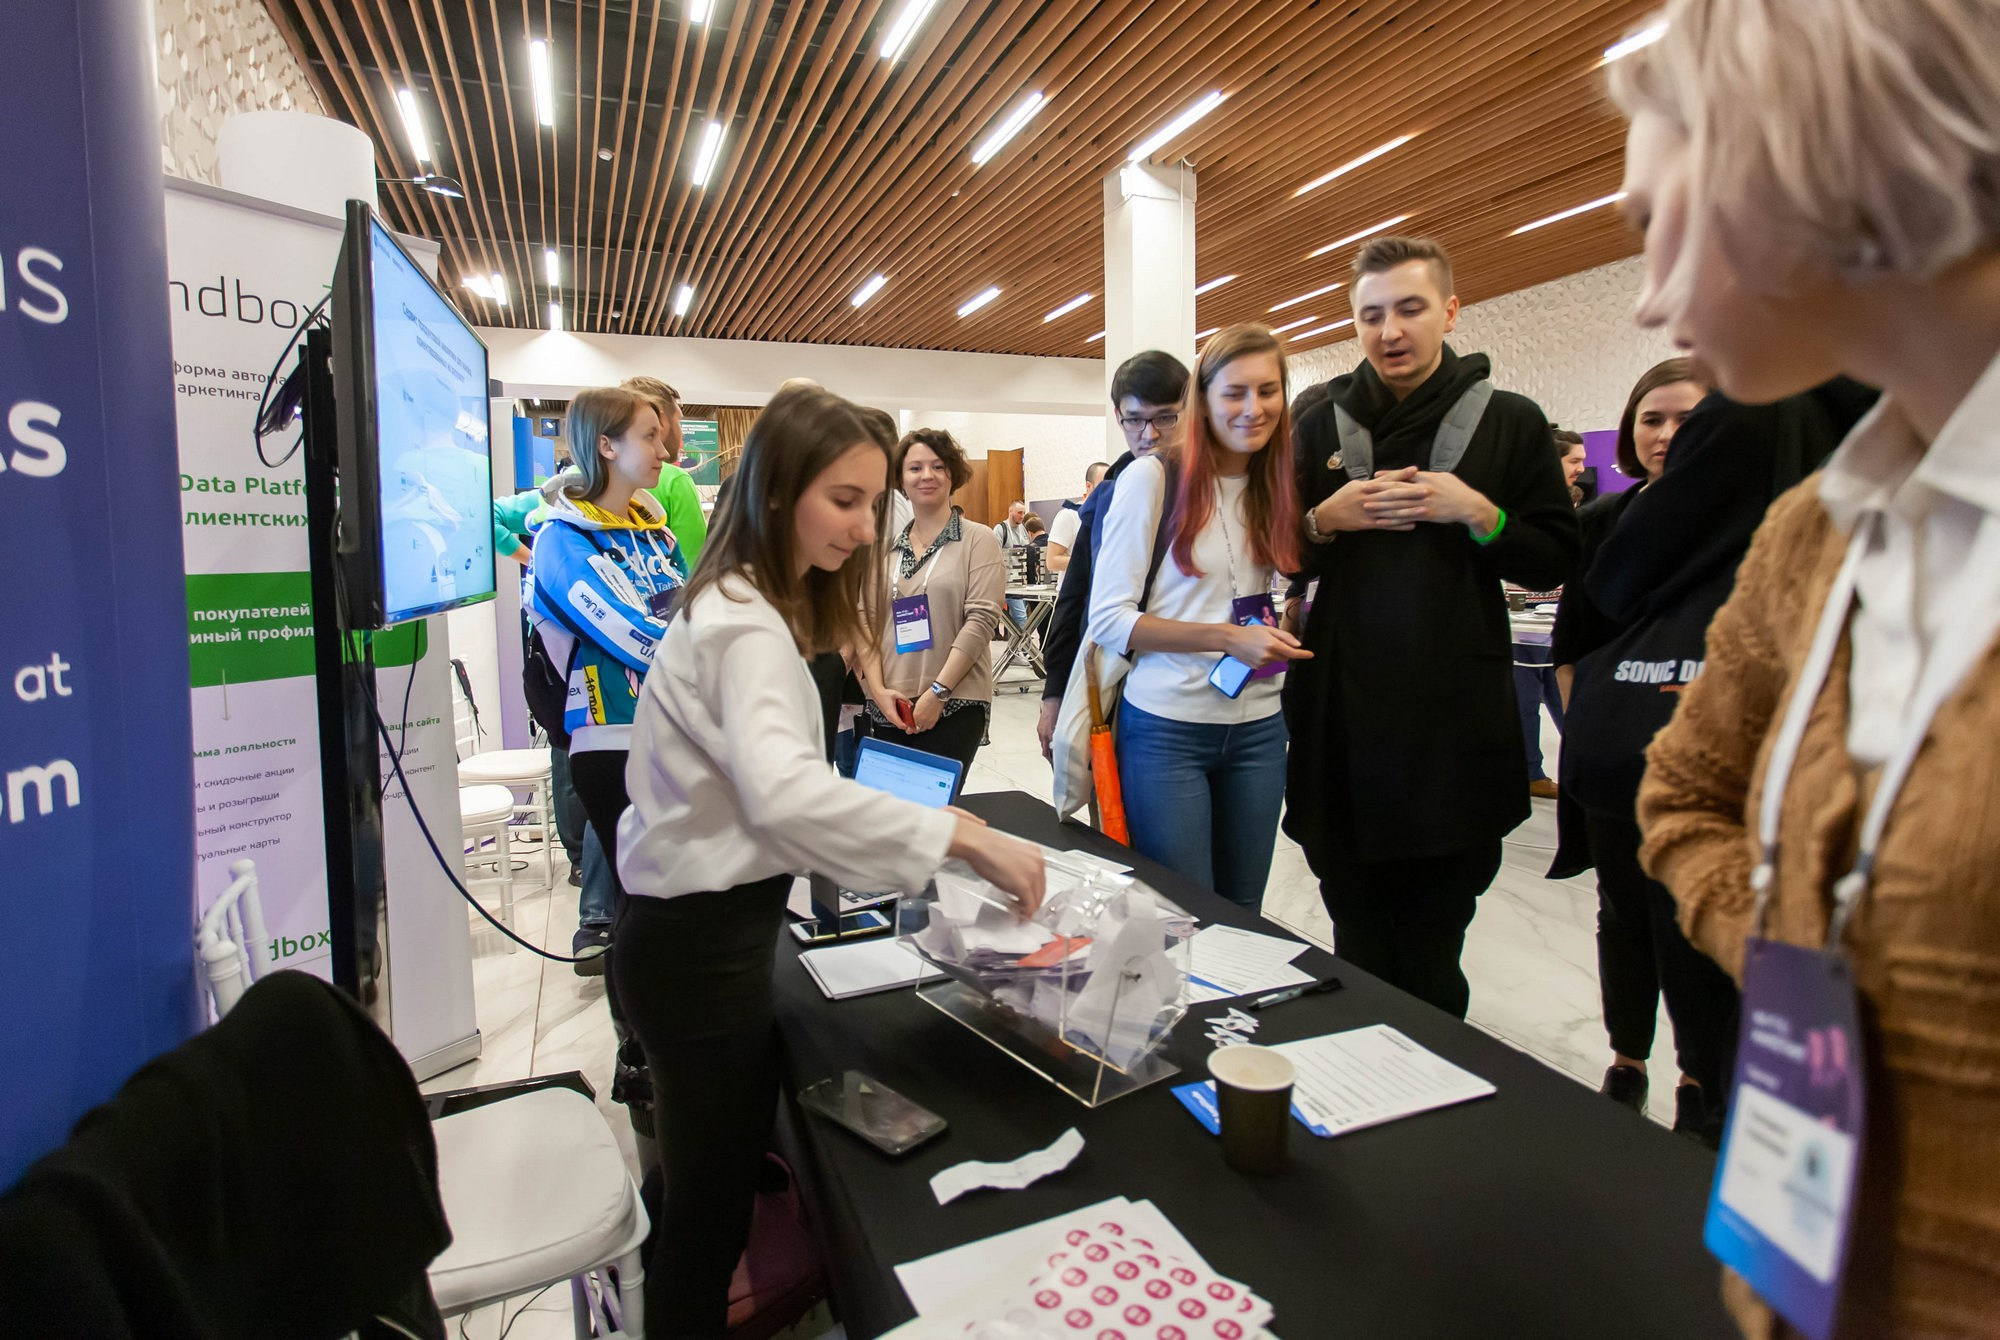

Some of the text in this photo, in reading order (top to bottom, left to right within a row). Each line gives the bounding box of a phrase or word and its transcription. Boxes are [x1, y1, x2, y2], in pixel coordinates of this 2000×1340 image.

[0, 248, 69, 323] s
[0, 401, 67, 477] s
[180, 474, 236, 494] Data
[193, 603, 311, 623] покупателей
[190, 628, 242, 644] иный
[15, 652, 73, 702] at
[1614, 659, 1676, 684] SONIC
[416, 717, 441, 728] сайта
[223, 737, 297, 755] лояльности
[203, 772, 262, 789] скидочные
[264, 766, 296, 779] акции
[404, 763, 437, 776] контент
[0, 759, 81, 824] m
[208, 801, 217, 811] и
[218, 791, 281, 811] розыгрыши
[228, 811, 292, 831] конструктор
[248, 836, 282, 853] карты
